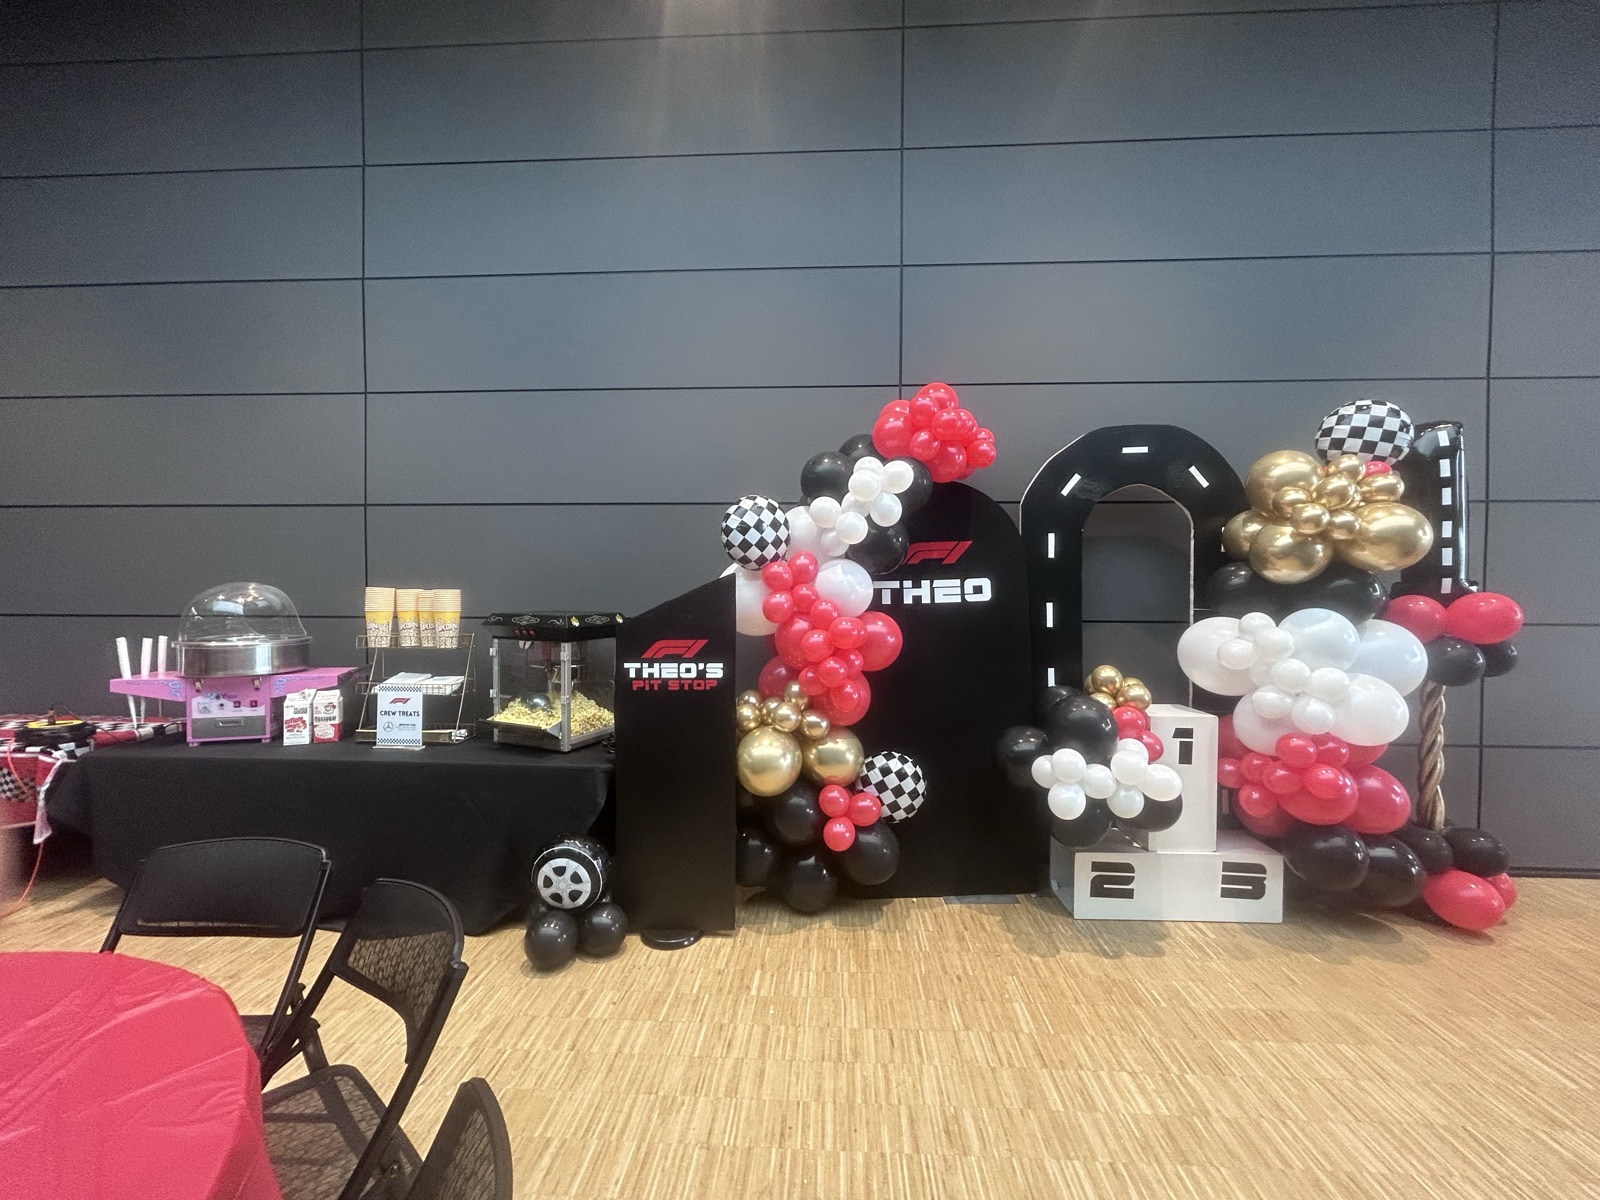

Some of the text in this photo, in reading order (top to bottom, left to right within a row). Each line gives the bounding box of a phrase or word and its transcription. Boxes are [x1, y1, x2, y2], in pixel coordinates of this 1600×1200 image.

[873, 578, 992, 604] THEO
[641, 639, 709, 659] F1
[623, 662, 724, 679] THEO'S
[667, 680, 718, 691] STOP
[1172, 727, 1194, 765] 1
[1089, 861, 1135, 899] 2
[1220, 861, 1267, 900] 3
